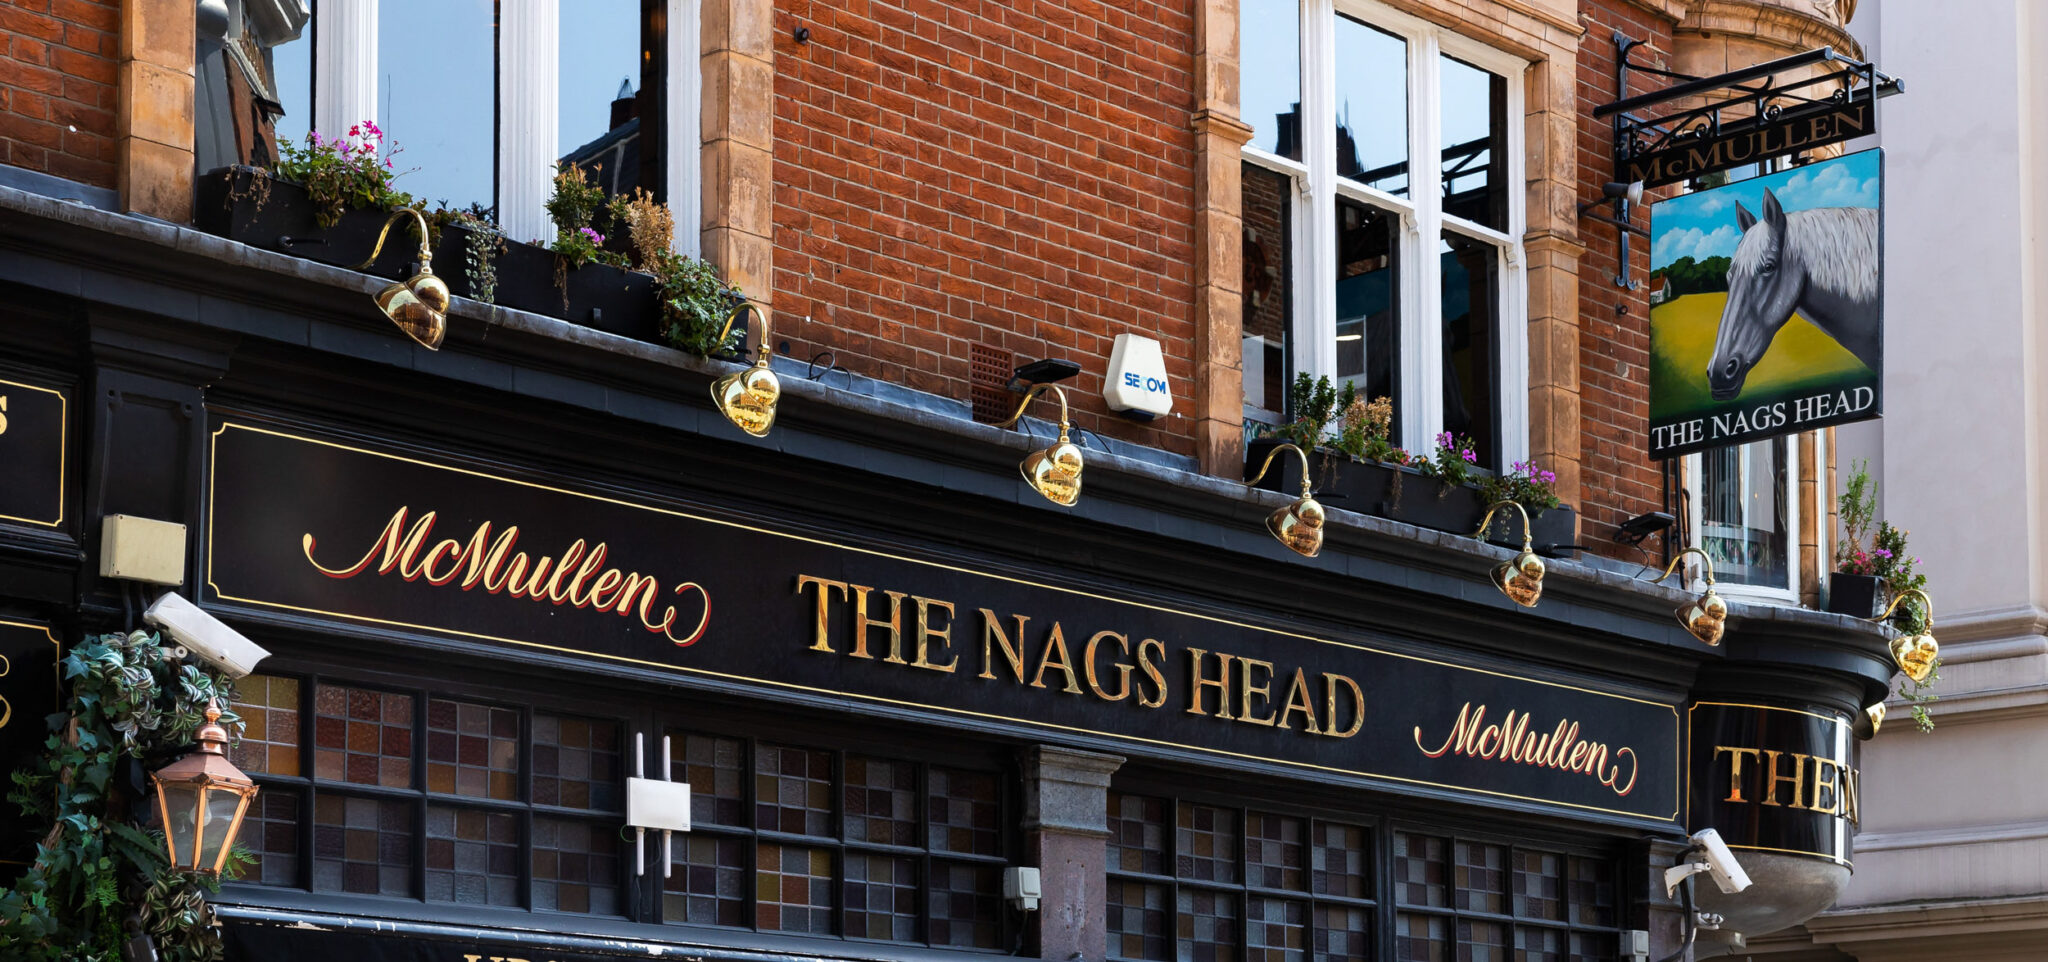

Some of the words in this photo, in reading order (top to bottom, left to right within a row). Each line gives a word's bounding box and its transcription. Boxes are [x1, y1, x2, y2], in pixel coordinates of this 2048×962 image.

[1124, 371, 1167, 395] SECOM
[1652, 419, 1705, 450] THE
[1710, 402, 1787, 440] NAGS
[1793, 386, 1875, 424] HEAD
[302, 505, 711, 647] McMullen
[797, 573, 959, 675] THE
[978, 606, 1169, 711] NAGS
[1186, 646, 1366, 739] HEAD
[1413, 701, 1638, 796] McMullen
[1713, 745, 1839, 815] THE
